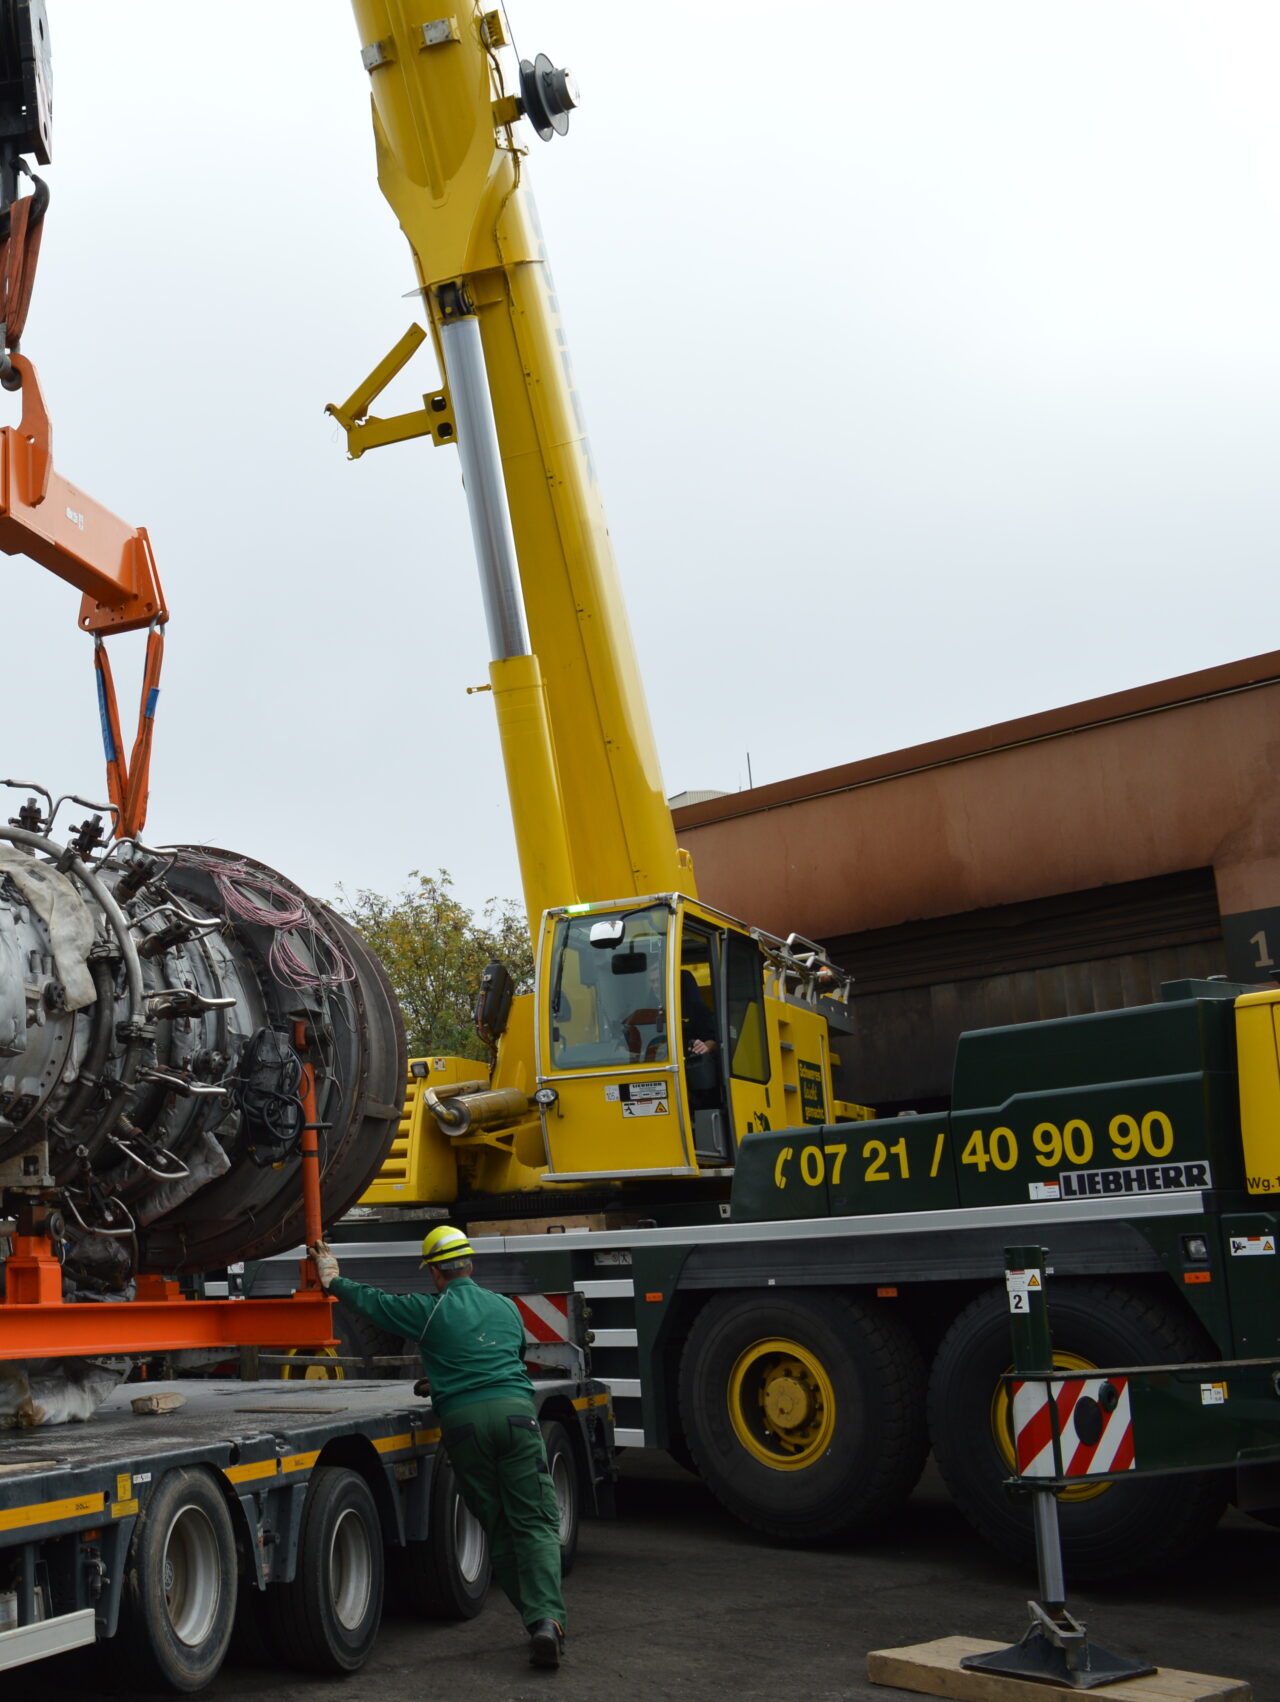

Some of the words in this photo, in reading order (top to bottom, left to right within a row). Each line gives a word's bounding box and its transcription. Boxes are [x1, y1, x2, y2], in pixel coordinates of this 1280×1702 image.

[1249, 930, 1275, 967] 1
[800, 1143, 847, 1187] 07
[862, 1137, 910, 1182] 21
[961, 1126, 1019, 1173] 40
[1032, 1118, 1094, 1168] 90
[1108, 1110, 1174, 1161] 90
[1063, 1164, 1209, 1197] LIEBHERR
[1013, 1294, 1023, 1310] 2
